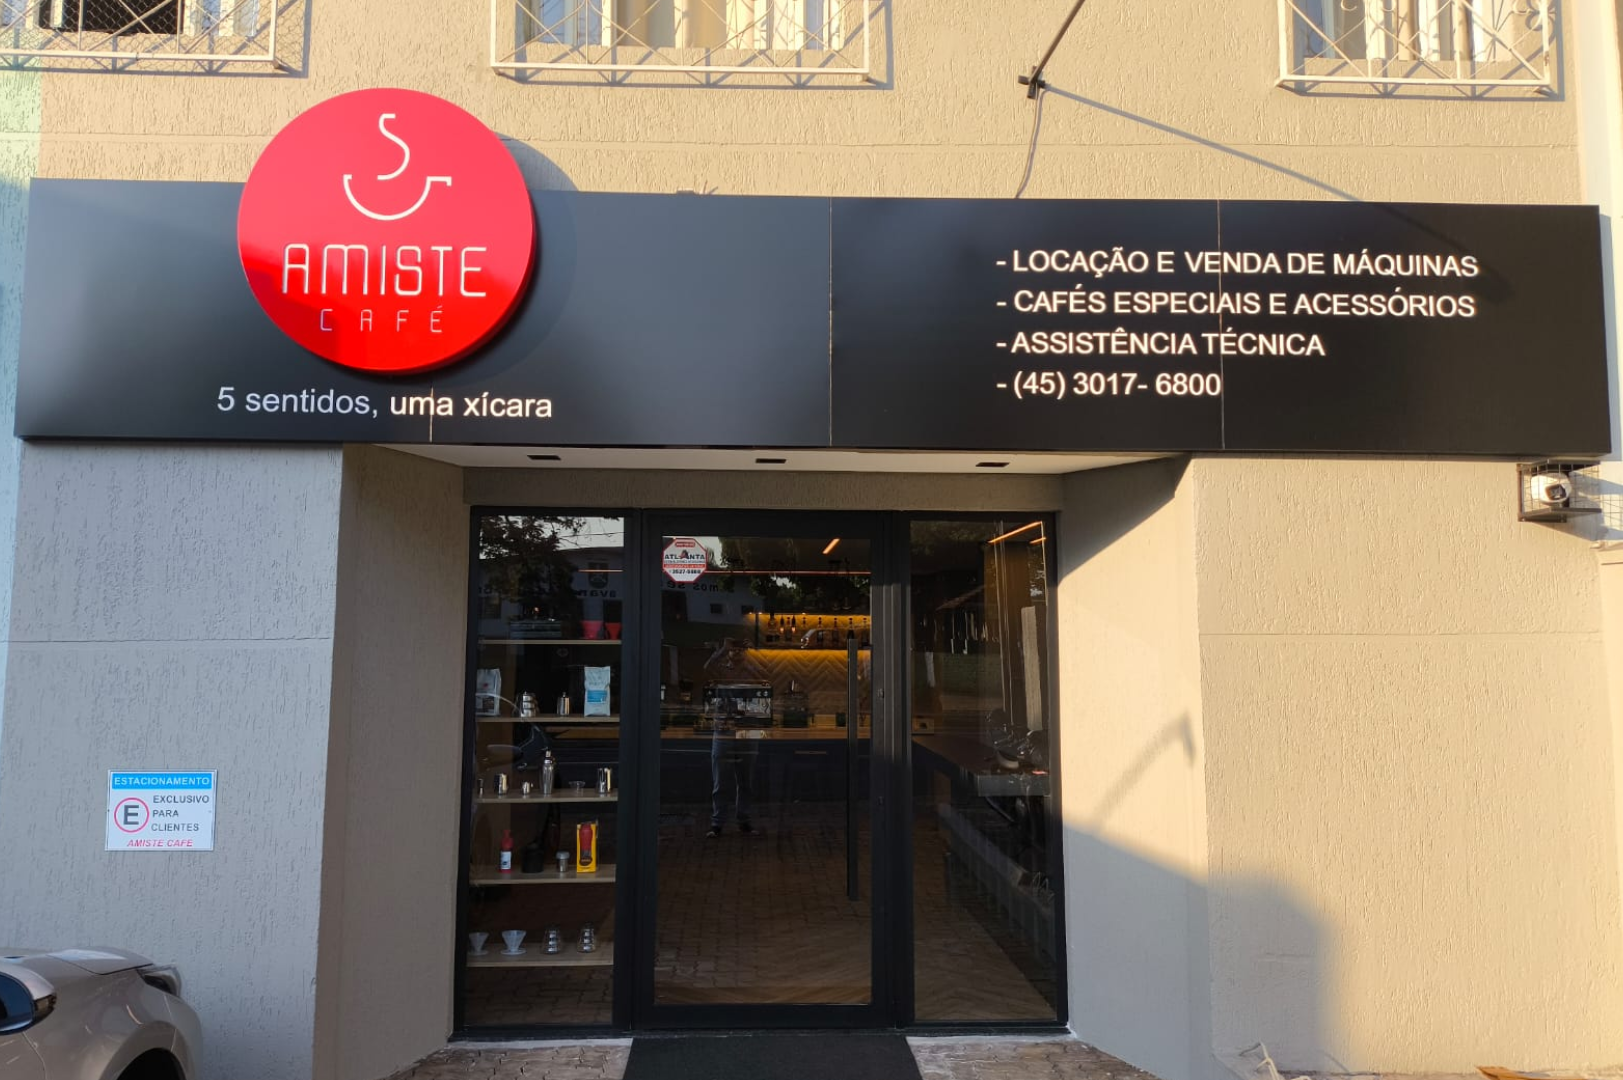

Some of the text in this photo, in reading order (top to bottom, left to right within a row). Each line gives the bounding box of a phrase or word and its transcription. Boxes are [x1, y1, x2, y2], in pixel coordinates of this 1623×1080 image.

[282, 243, 487, 297] AMISTE
[1013, 246, 1149, 279] LOCAÇÃO
[1156, 250, 1175, 273] E
[1183, 251, 1283, 275] VENDA
[1287, 252, 1326, 275] DE
[1333, 248, 1480, 278] MÁQUINAS
[1013, 284, 1107, 314] CAFÉS
[1113, 291, 1262, 315] ESPECIAIS
[1269, 292, 1287, 315] E
[1292, 287, 1476, 318] ACESSÓRIOS
[320, 305, 443, 333] CAFÉ
[1010, 327, 1198, 355] ASSISTÊNCIA
[1200, 327, 1326, 356] TÉCNICA
[1013, 370, 1066, 400] (45)
[1072, 371, 1148, 396] 3017-
[1155, 372, 1222, 396] 6800
[217, 386, 553, 419] 5 sentidos, uma xícara
[664, 549, 705, 560] ATLANTA
[114, 777, 210, 785] ESTACIONAMENTO
[153, 795, 210, 803] EXCLUSIVO
[123, 804, 140, 826] E
[152, 809, 179, 818] PARA
[151, 823, 200, 832] CLIENTES
[127, 839, 164, 847] AMISTE
